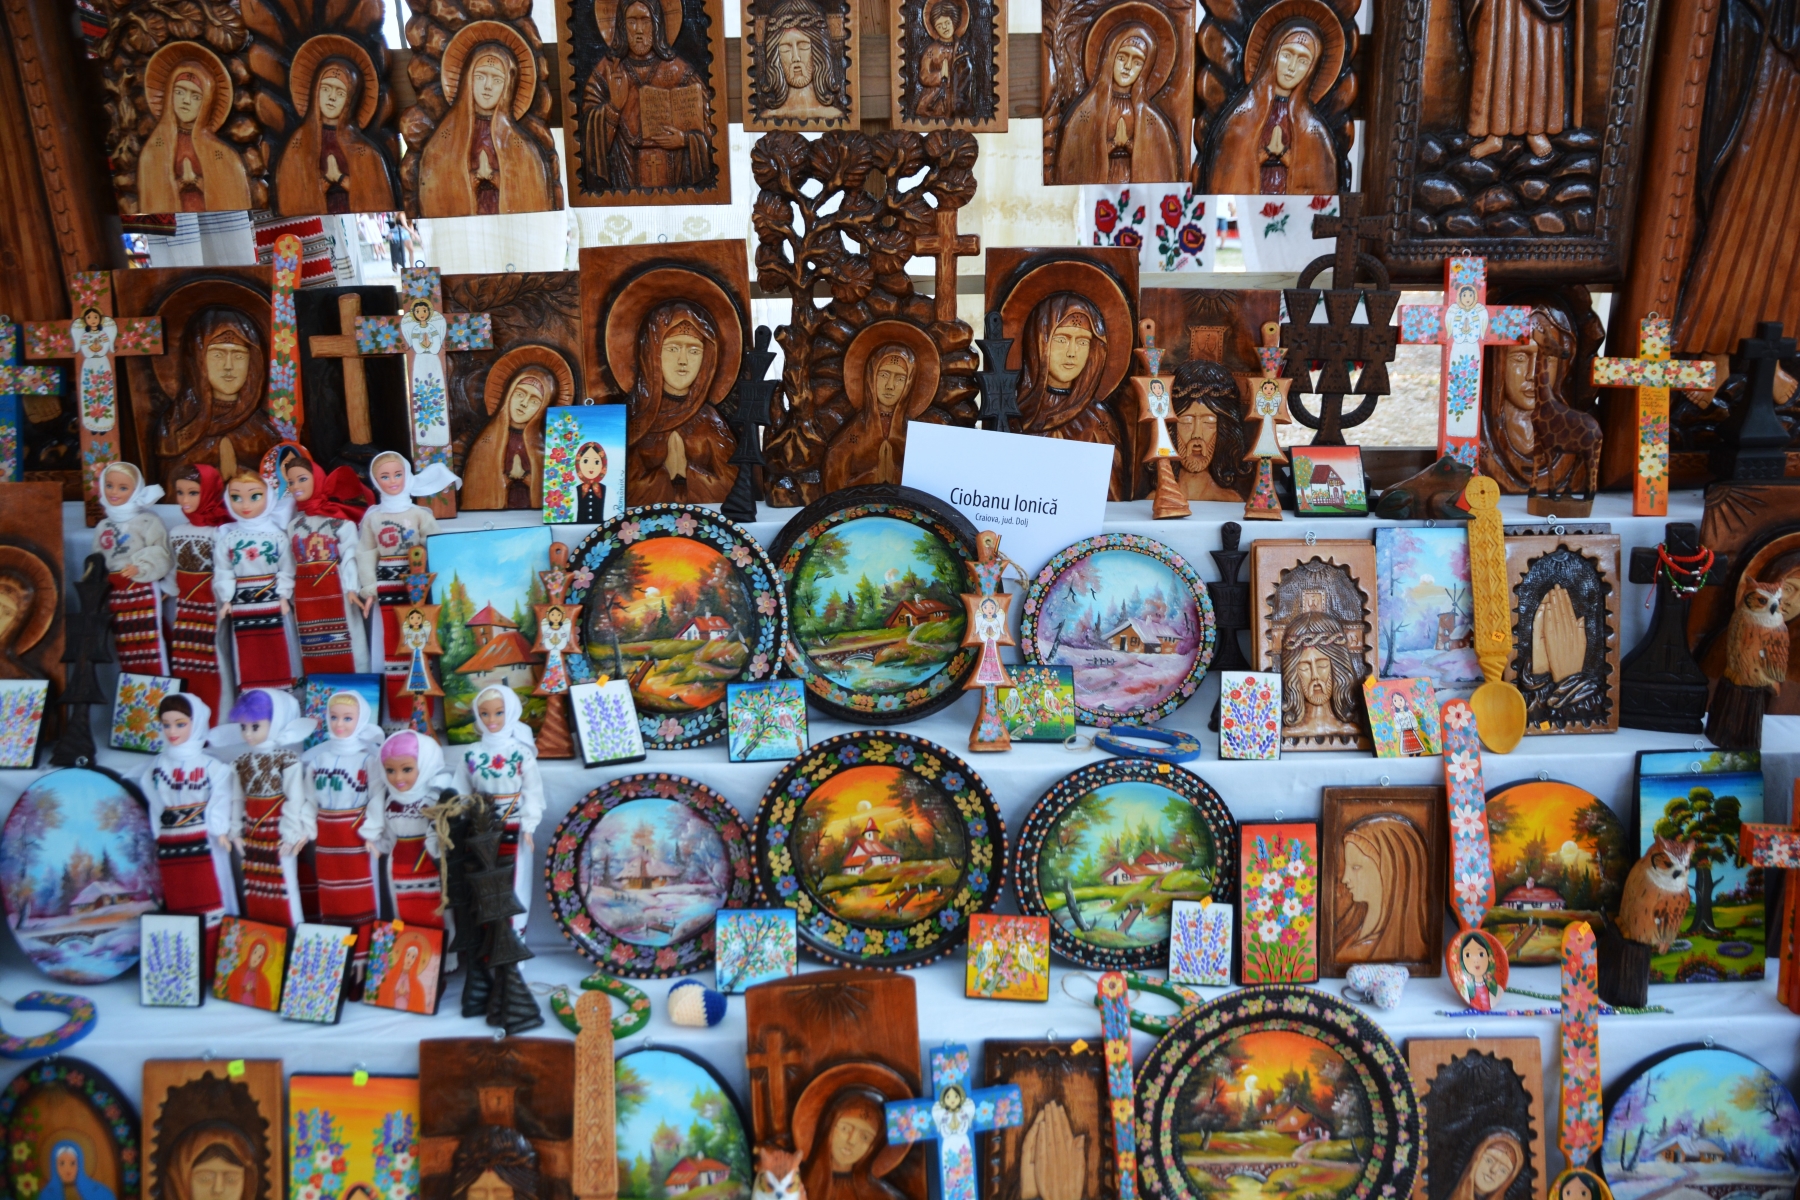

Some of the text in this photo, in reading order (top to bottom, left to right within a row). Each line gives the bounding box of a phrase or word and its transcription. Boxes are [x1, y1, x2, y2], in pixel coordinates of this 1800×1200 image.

[949, 487, 1058, 515] Ciobanu Ionică
[975, 513, 1029, 527] Craiova, jud. Dolj
